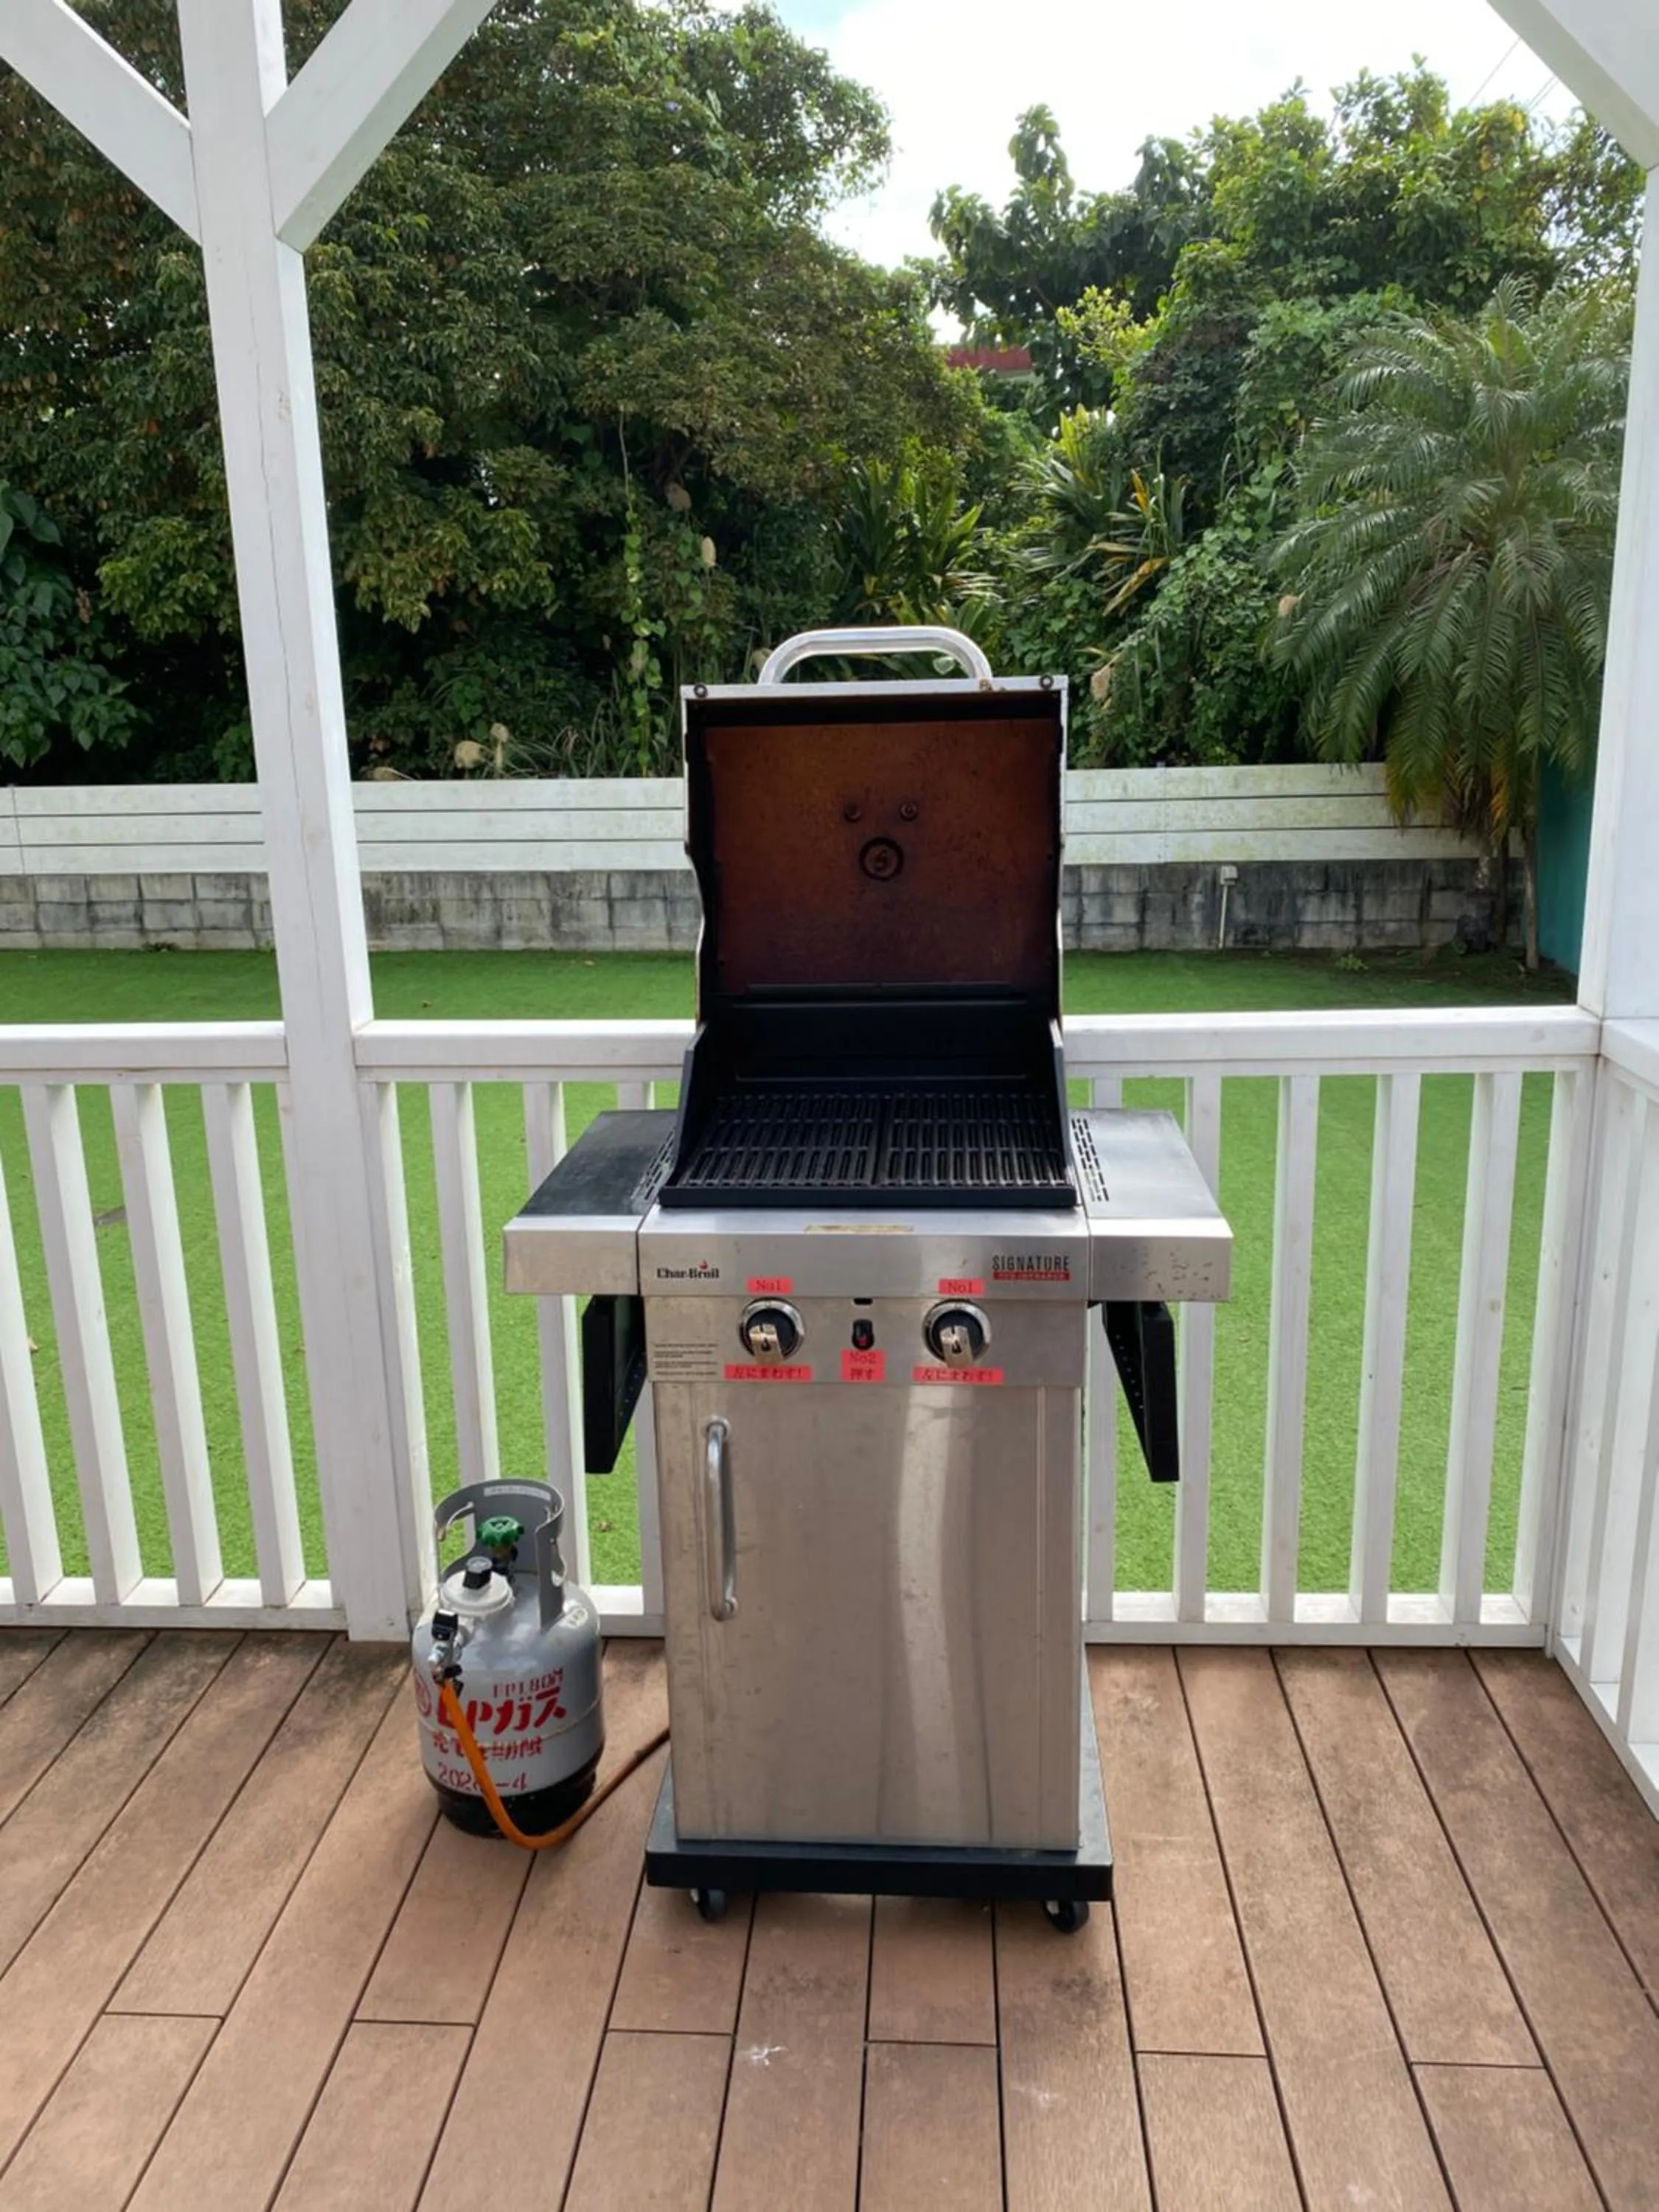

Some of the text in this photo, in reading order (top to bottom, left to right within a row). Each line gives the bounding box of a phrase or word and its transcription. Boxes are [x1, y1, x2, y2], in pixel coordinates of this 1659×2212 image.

[992, 1254, 1070, 1270] SIGNATURE
[755, 1279, 782, 1292] No1
[947, 1281, 973, 1294] No1
